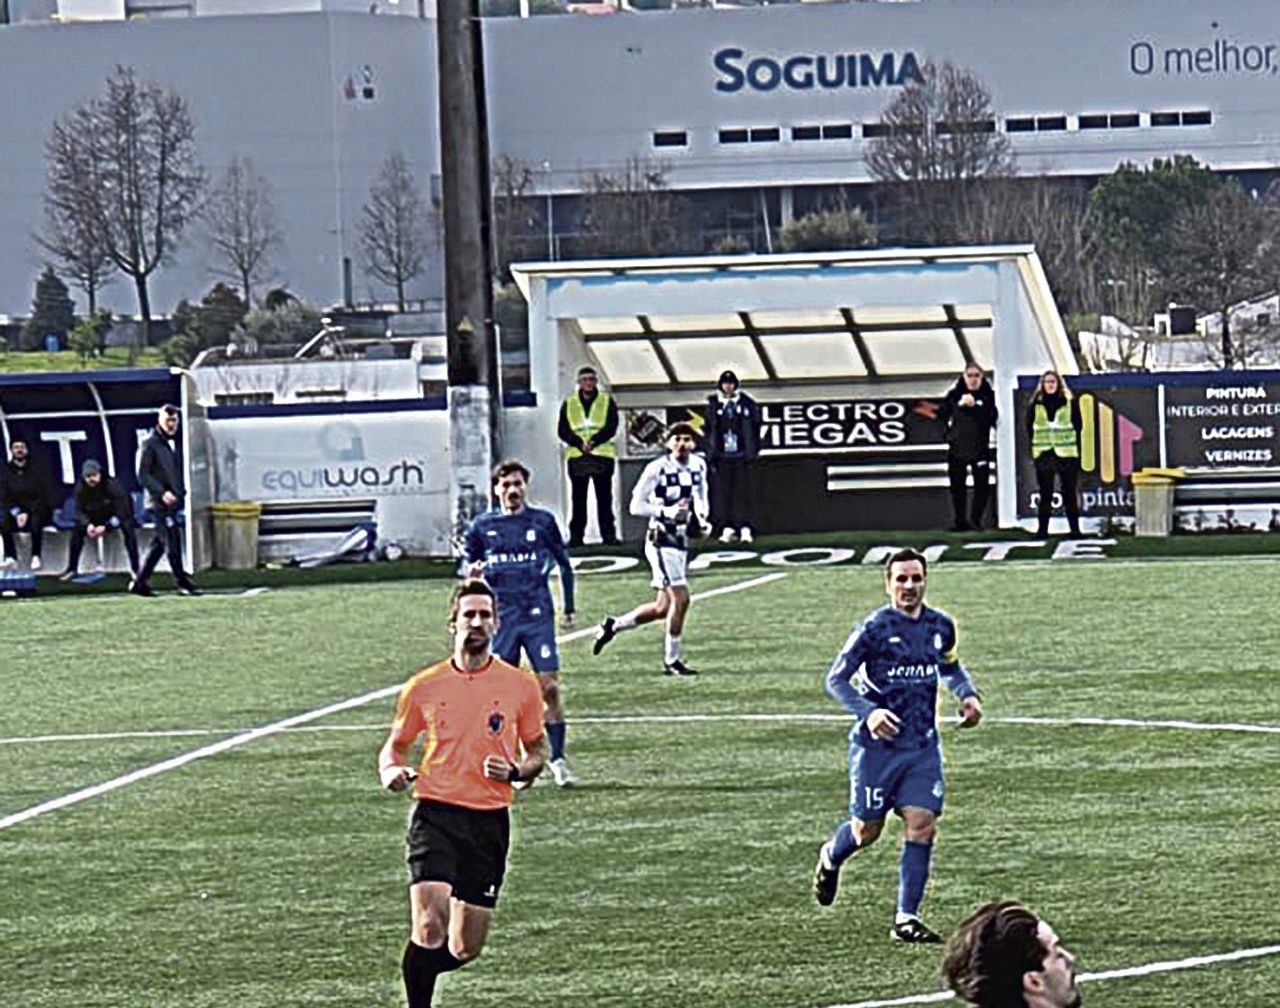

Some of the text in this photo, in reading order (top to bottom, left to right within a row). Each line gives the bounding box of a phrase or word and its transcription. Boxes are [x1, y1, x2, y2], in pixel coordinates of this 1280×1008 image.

[1130, 42, 1153, 75] O
[1164, 39, 1278, 75] melhor,
[1206, 386, 1267, 399] PINTURA
[762, 402, 905, 422] LECTRO
[1167, 404, 1228, 417] INTERIOR
[1232, 403, 1239, 416] E
[1205, 449, 1272, 462] VERNIZES
[865, 787, 884, 809] 15
